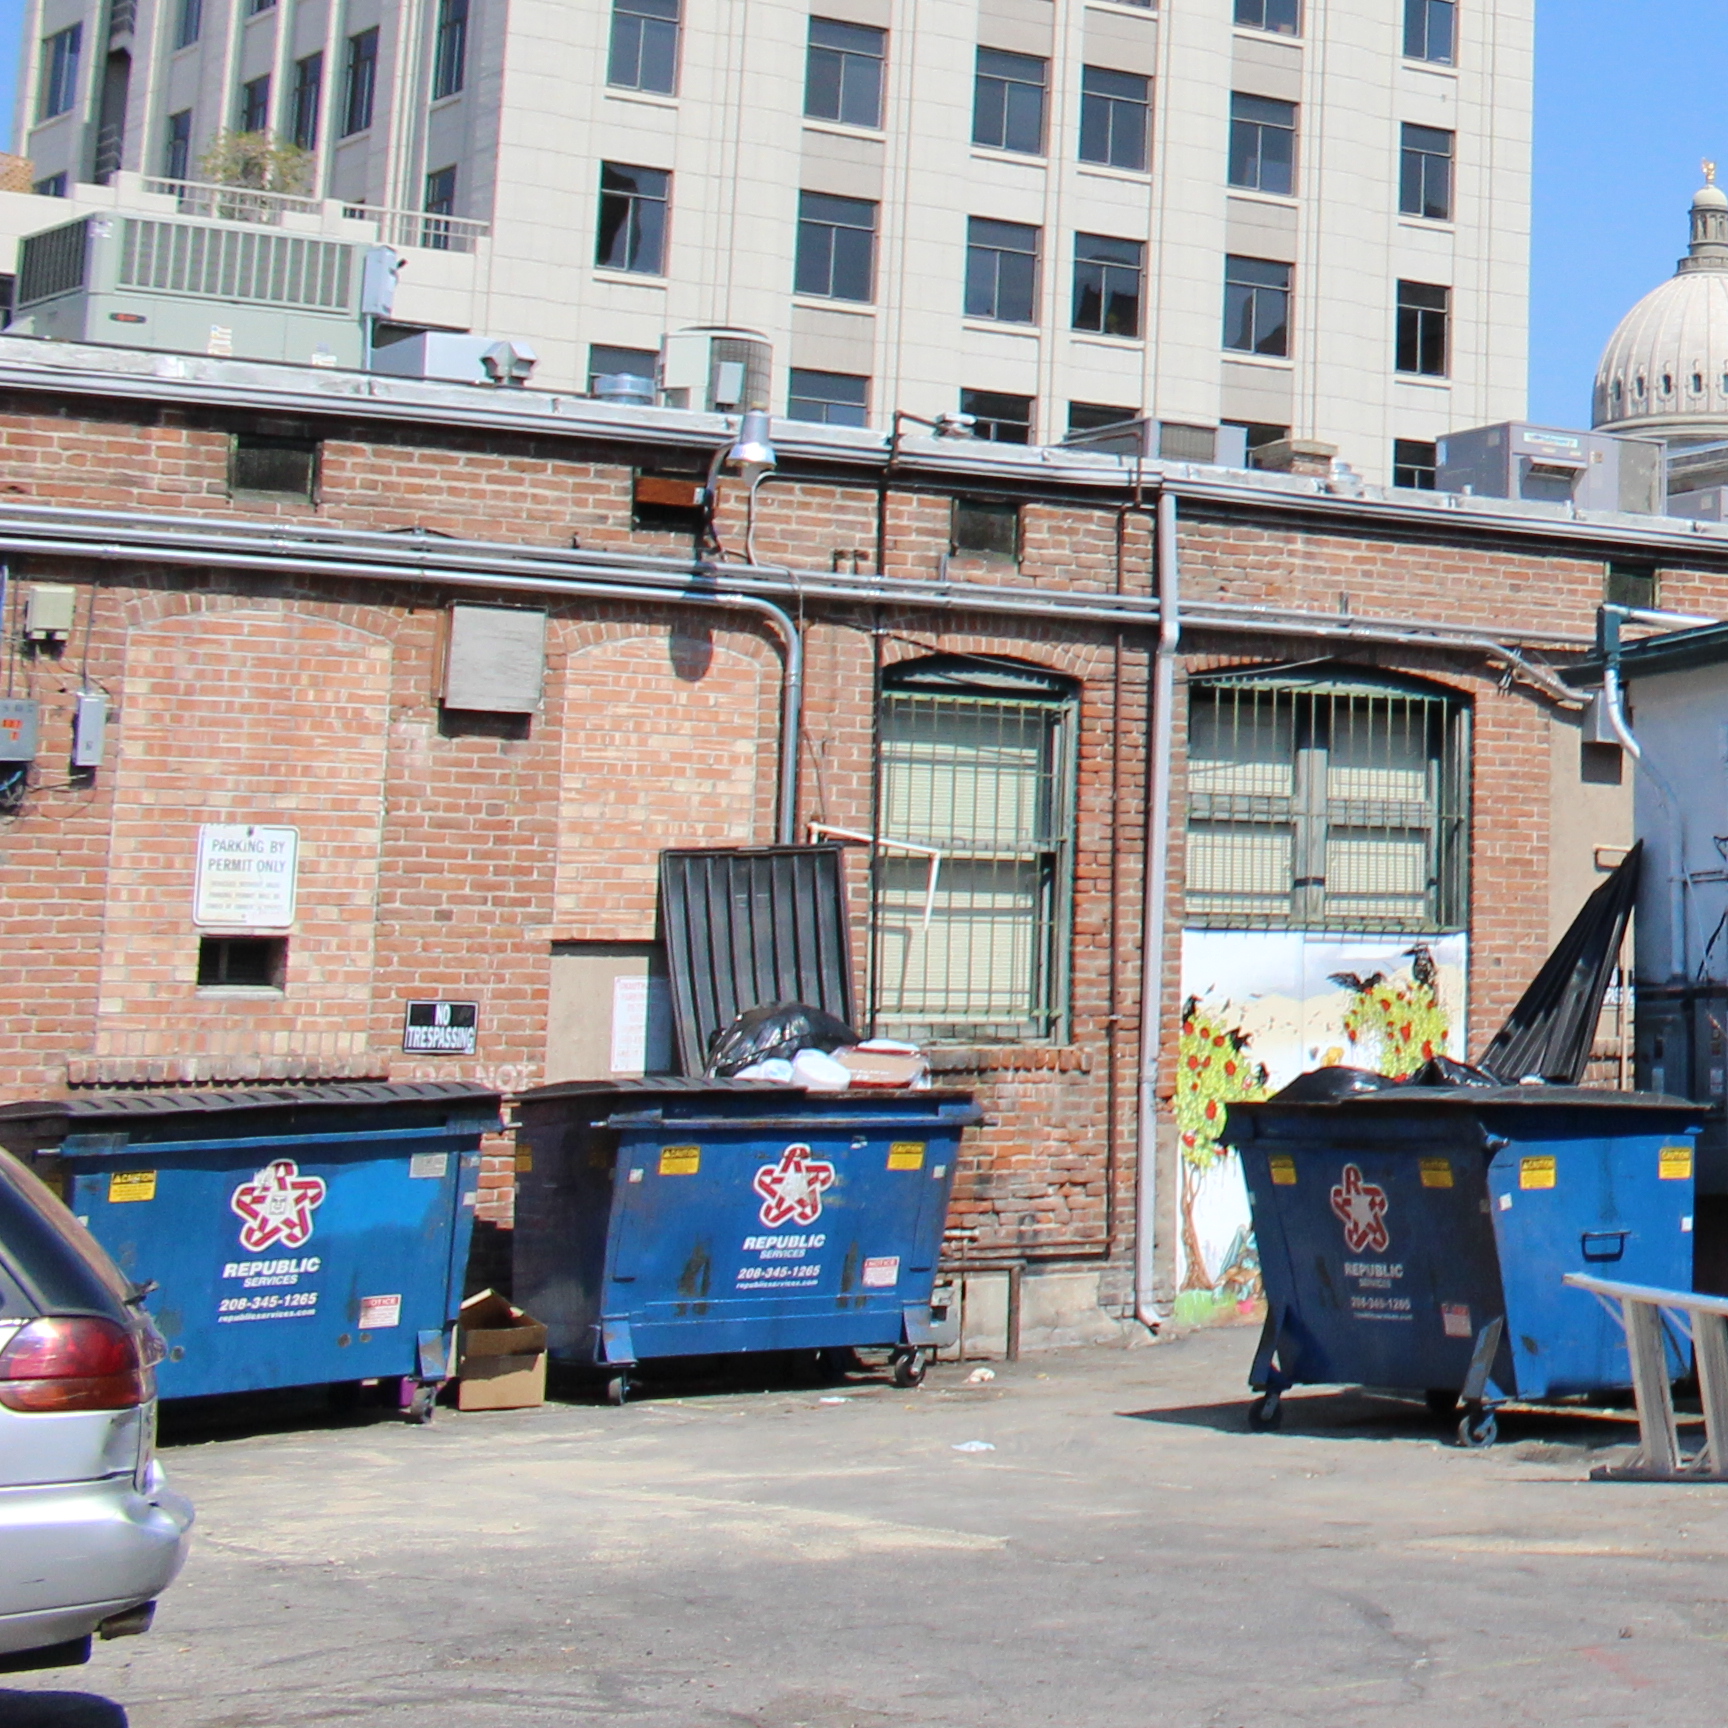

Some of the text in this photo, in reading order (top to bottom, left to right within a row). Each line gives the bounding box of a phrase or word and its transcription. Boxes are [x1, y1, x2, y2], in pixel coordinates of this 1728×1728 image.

[212, 839, 286, 854] PARKING BY
[208, 858, 287, 873] PERMIT ONLY
[435, 1003, 451, 1026] NO
[407, 1026, 475, 1049] TRESPASSING
[742, 1234, 825, 1251] REPUBLIC
[760, 1248, 806, 1260] SERVICES
[222, 1256, 321, 1279] REPUBLIC
[737, 1264, 820, 1280] 208-345-1265
[1344, 1262, 1403, 1278] REPUBLIC
[242, 1274, 298, 1288] SERVICES
[218, 1292, 319, 1312] 208-345-1265
